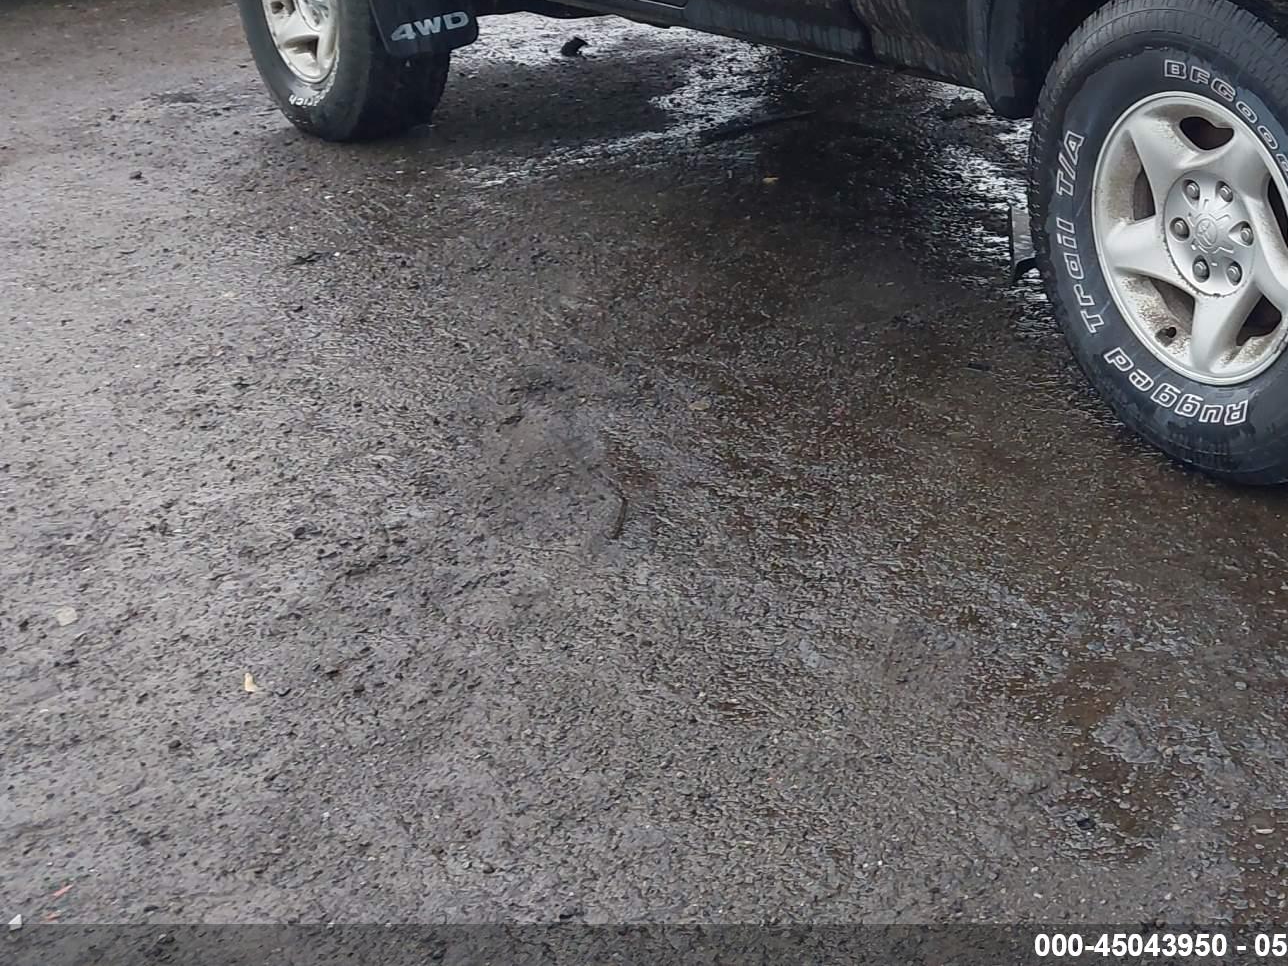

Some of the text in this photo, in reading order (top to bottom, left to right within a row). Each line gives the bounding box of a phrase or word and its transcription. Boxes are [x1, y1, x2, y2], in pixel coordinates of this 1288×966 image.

[391, 11, 470, 41] 4WD
[1056, 130, 1249, 426] Rugged Trail T/A
